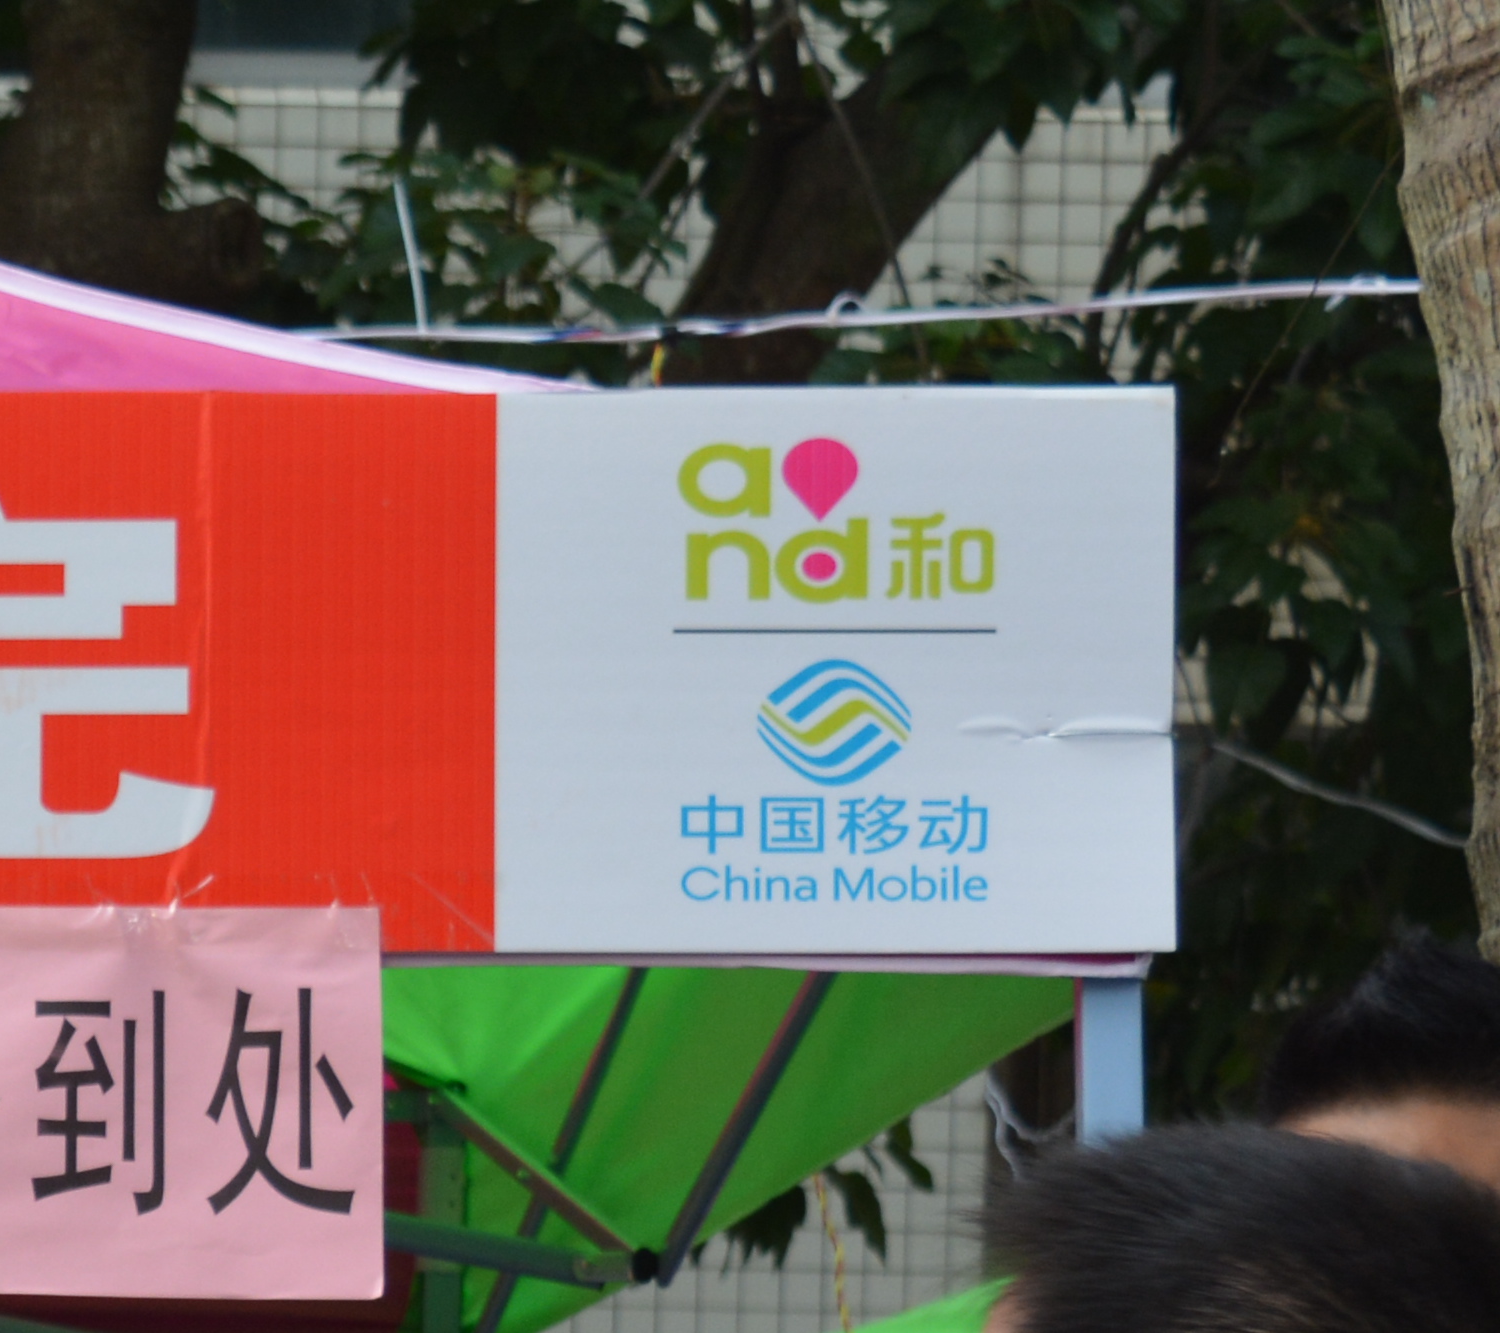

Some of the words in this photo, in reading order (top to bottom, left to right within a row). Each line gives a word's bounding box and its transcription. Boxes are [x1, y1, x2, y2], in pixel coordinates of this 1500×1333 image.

[679, 794, 990, 856] 中国移动
[680, 864, 820, 903] China
[832, 864, 989, 903] Mobile
